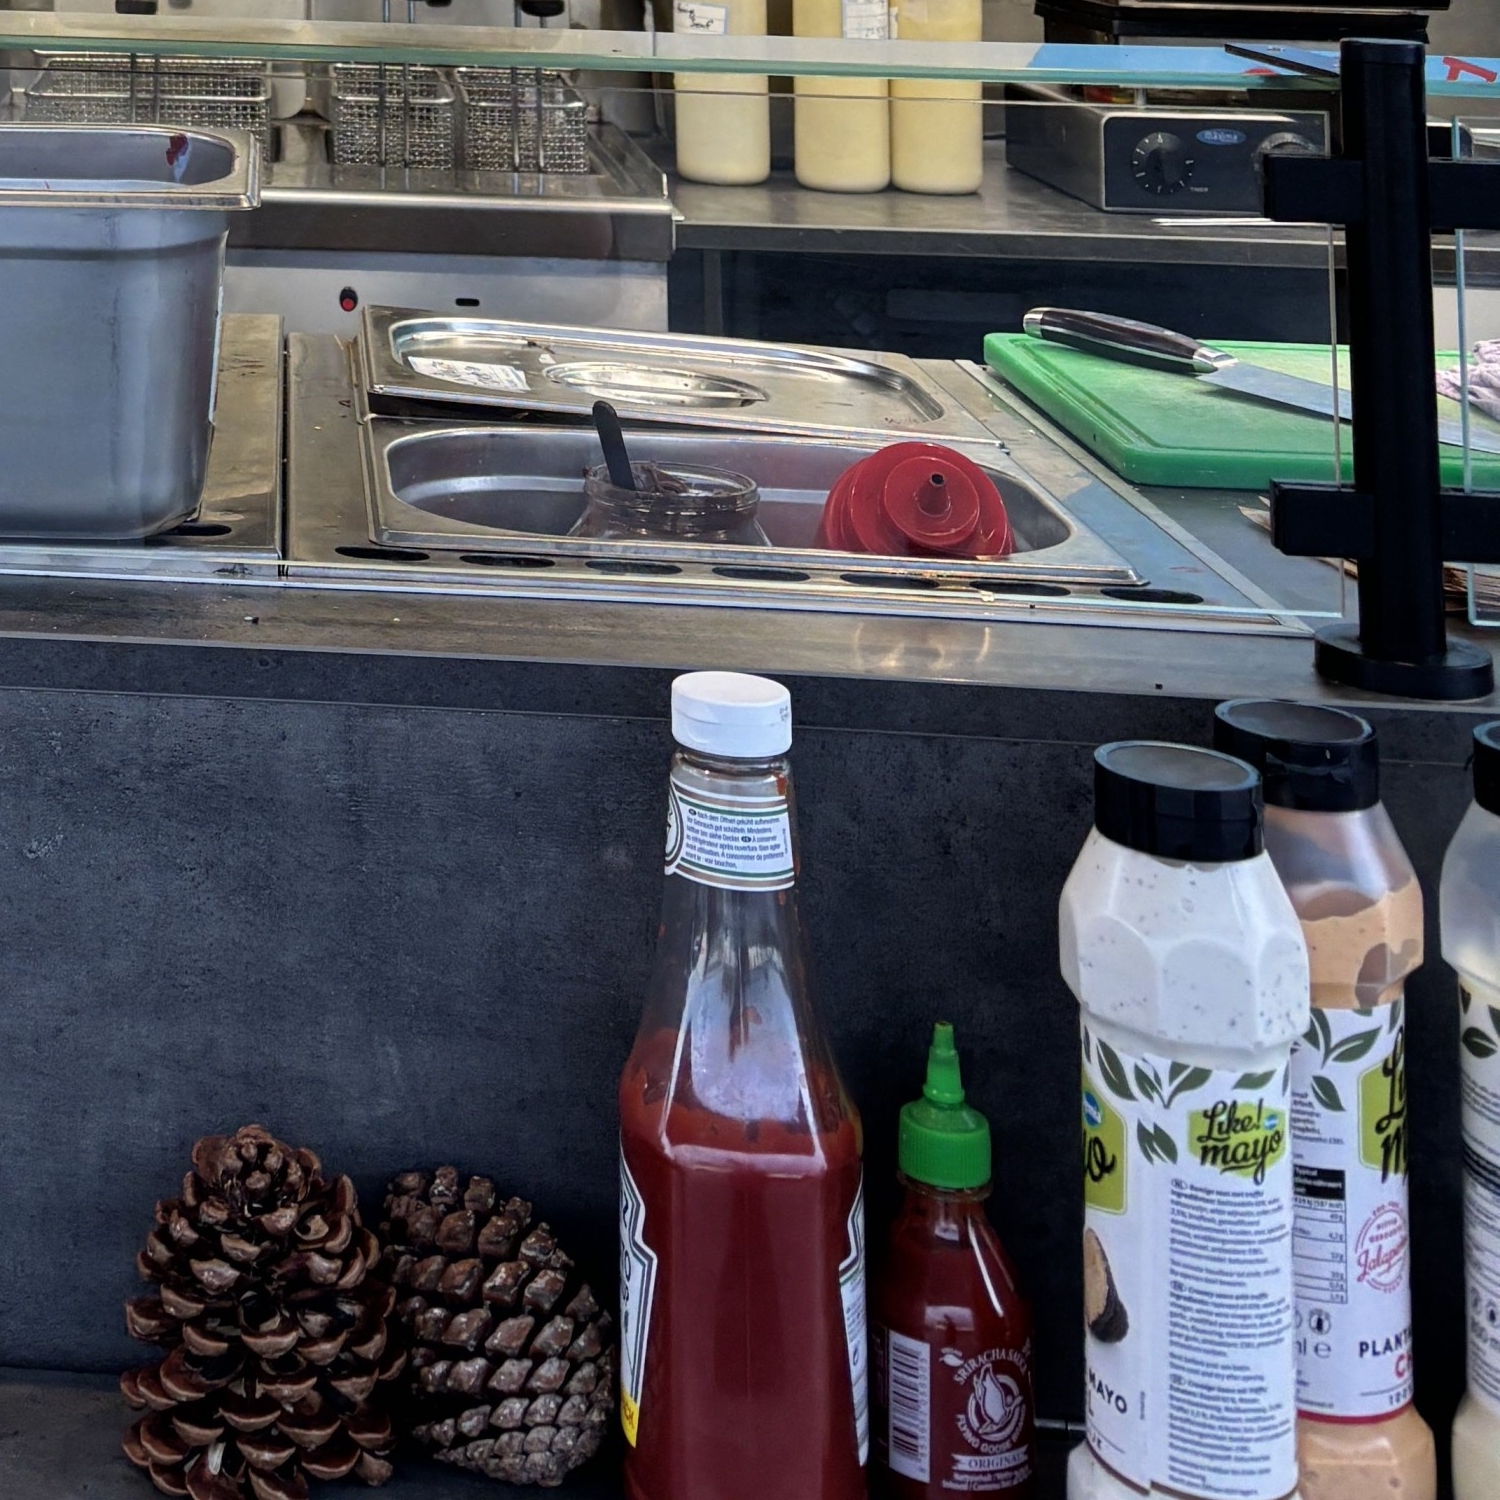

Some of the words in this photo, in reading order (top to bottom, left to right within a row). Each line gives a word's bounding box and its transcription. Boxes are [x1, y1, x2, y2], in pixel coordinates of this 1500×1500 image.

[1196, 1097, 1263, 1142] Like!
[1200, 1129, 1284, 1186] mayo
[953, 1348, 1006, 1386] SRIRACHA
